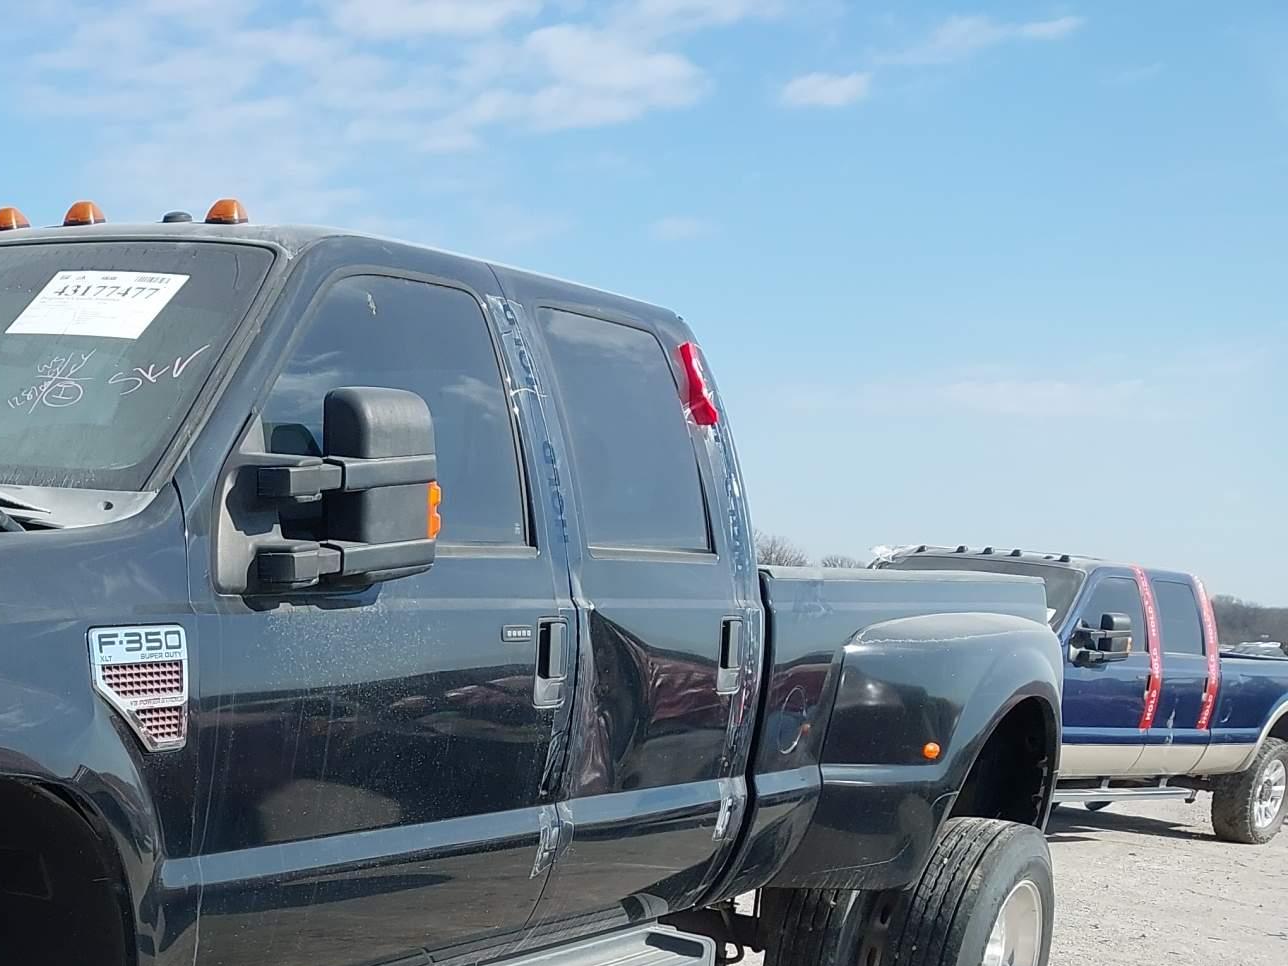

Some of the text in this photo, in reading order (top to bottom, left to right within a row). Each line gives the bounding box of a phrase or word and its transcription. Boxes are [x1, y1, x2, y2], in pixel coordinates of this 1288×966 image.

[54, 284, 160, 300] 43177477
[97, 630, 182, 653] F-350
[1145, 690, 1157, 721] HOLD
